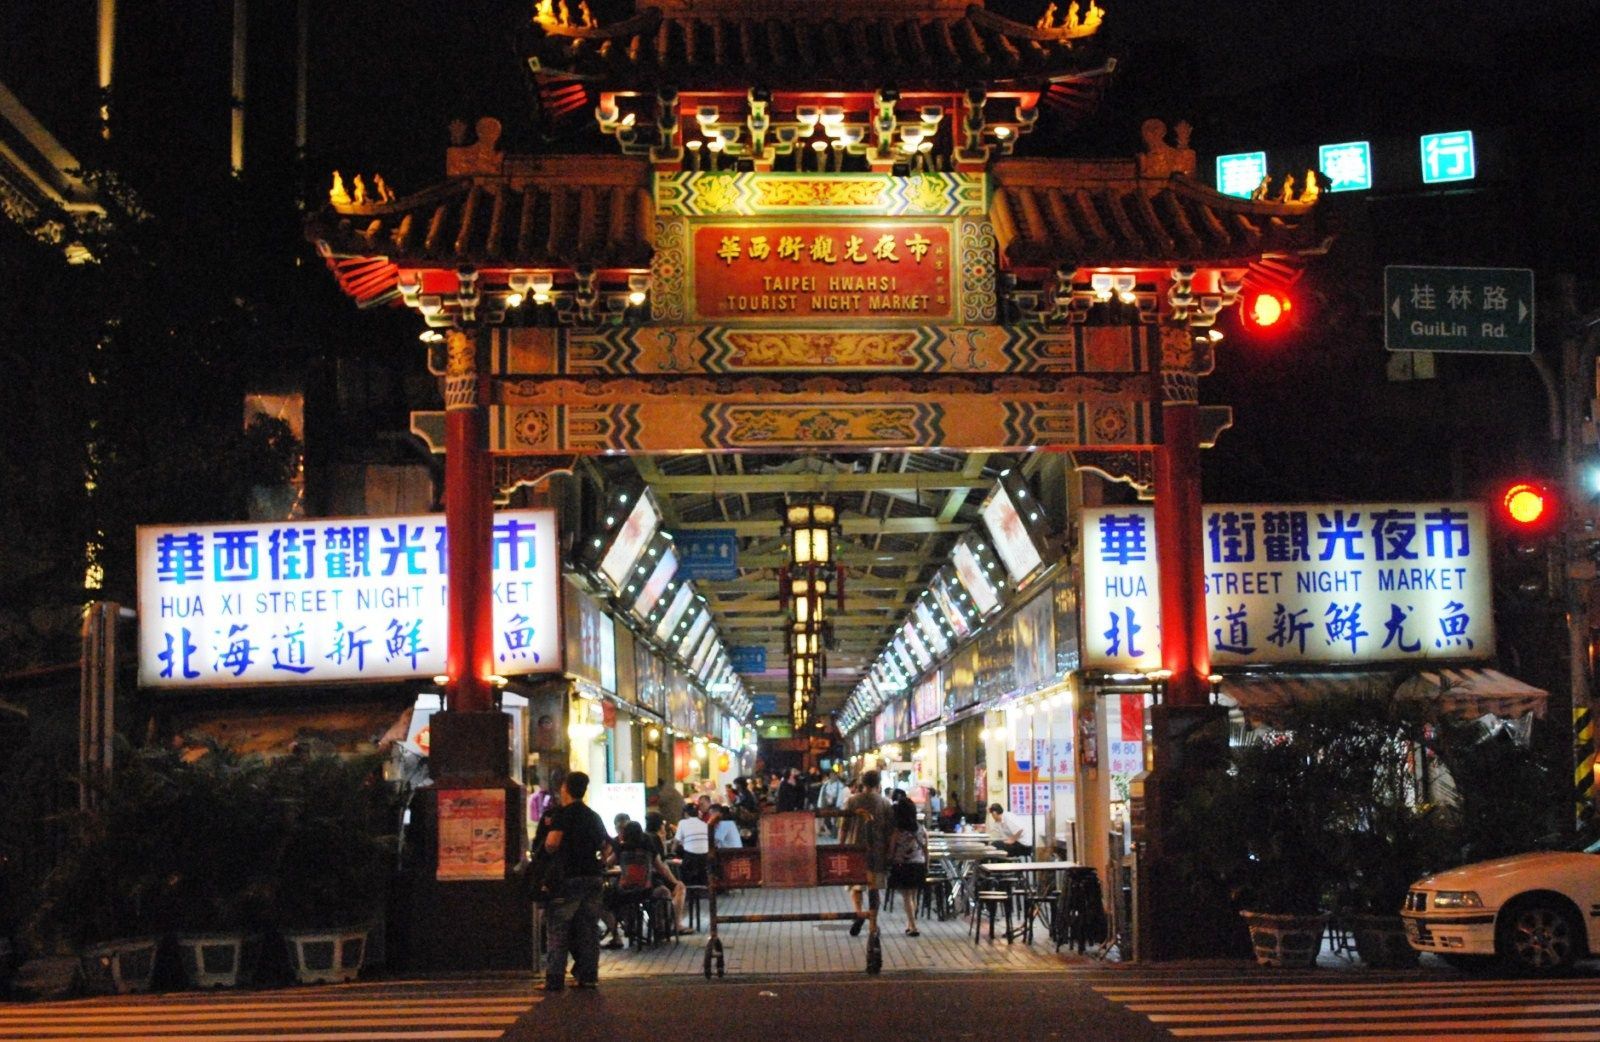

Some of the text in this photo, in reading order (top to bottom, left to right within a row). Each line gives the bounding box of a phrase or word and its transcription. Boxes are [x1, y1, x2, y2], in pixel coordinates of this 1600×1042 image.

[717, 233, 932, 264] 華西街觀光夜市
[763, 275, 897, 292] TAIPEI HWAHSI
[1410, 283, 1509, 310] 桂林路
[727, 295, 930, 311] TOURIST NIGHT MARKET
[1410, 320, 1467, 337] GuiLin
[157, 519, 536, 584] 華西街觀光市
[1099, 508, 1470, 565] 華街觀光夜市
[1105, 574, 1148, 598] HUA
[1297, 570, 1363, 593] NIGHT
[1378, 568, 1467, 591] MARKET
[161, 594, 203, 618] HUA
[221, 593, 242, 615] XI
[256, 589, 345, 614] STREET
[357, 585, 423, 610] NIGHT
[1103, 600, 1474, 657] 北道新鮮尤魚
[157, 613, 541, 679] 北海道新鮮魚
